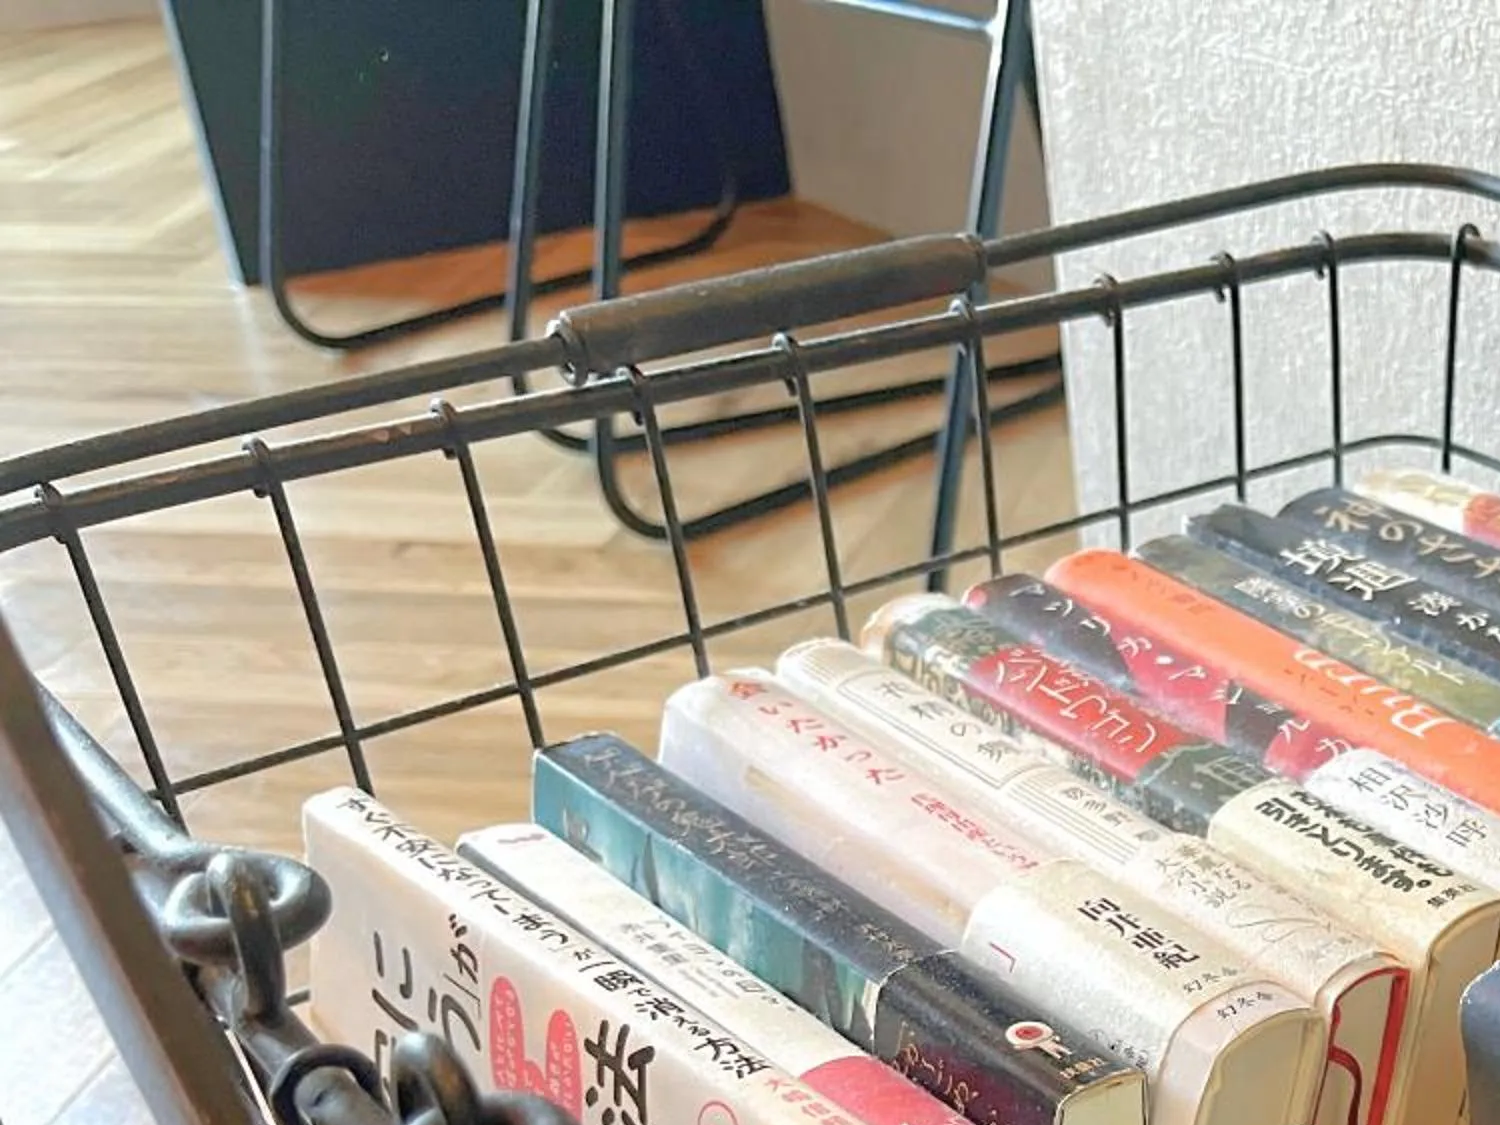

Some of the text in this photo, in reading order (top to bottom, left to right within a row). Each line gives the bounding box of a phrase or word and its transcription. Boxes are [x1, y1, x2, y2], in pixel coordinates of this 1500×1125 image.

[1347, 764, 1492, 849] 相沢沙呼
[1076, 896, 1201, 970] 向井亜紀
